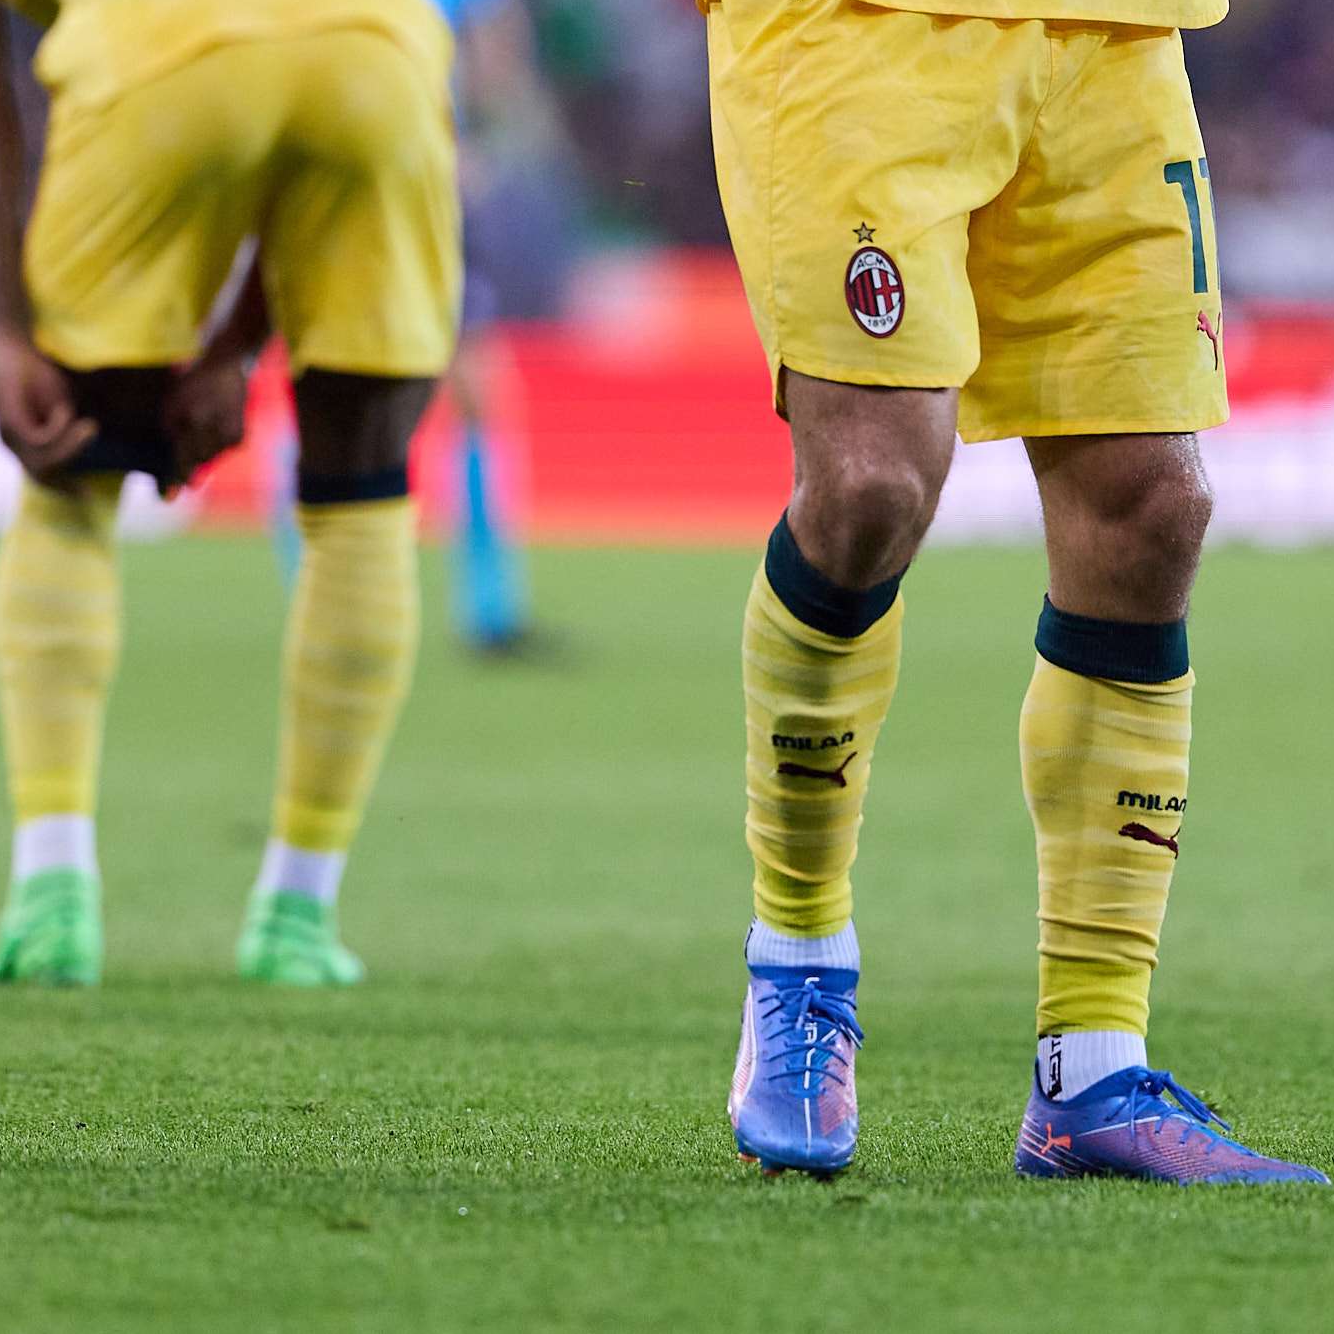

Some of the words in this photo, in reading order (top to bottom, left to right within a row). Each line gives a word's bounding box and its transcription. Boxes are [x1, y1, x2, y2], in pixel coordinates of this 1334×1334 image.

[855, 254, 887, 273] ACM
[867, 316, 894, 327] 1899
[1116, 790, 1187, 812] MILAN
